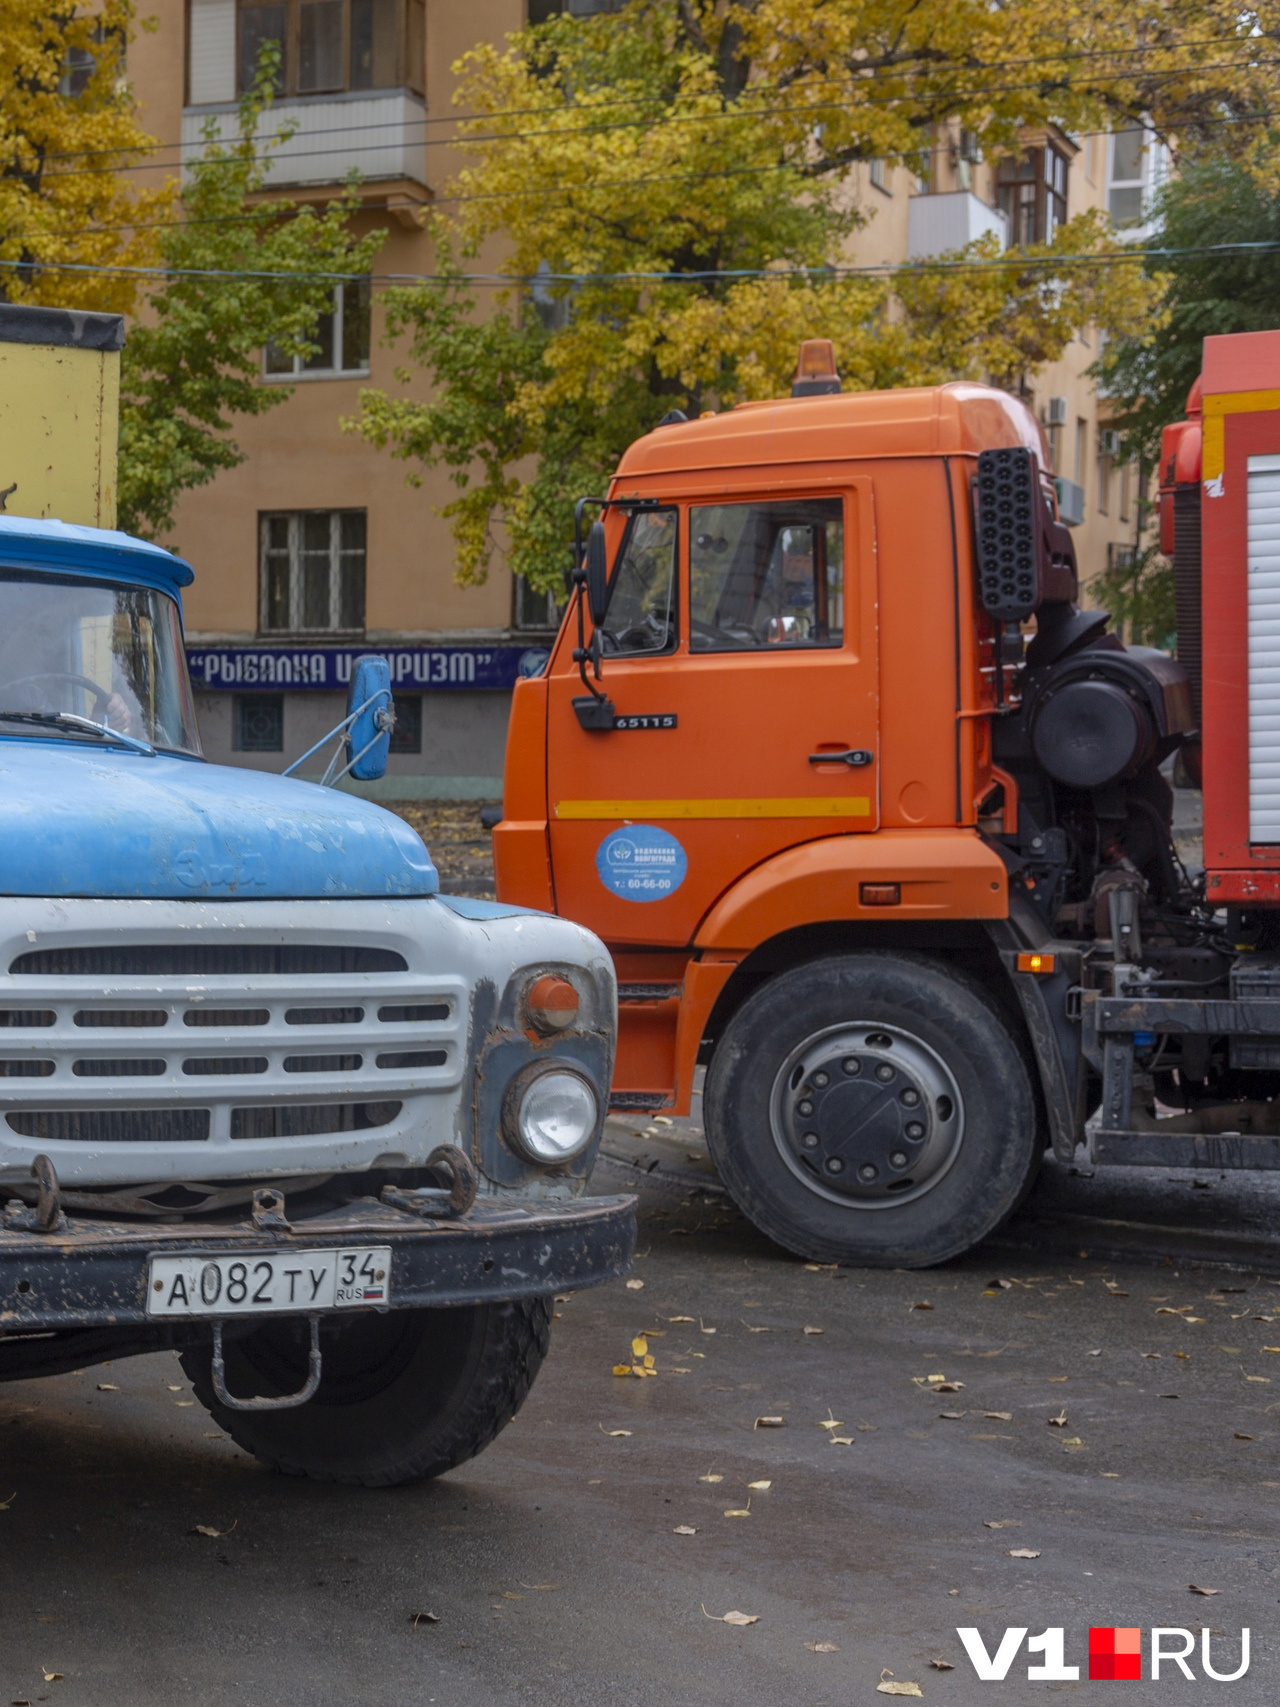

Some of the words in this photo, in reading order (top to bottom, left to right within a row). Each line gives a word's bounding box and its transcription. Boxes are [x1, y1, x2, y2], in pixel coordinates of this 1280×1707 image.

[616, 716, 674, 728] 65115
[627, 879, 671, 889] 60-66-00
[341, 1253, 377, 1287] 34
[336, 1287, 363, 1301] RUS
